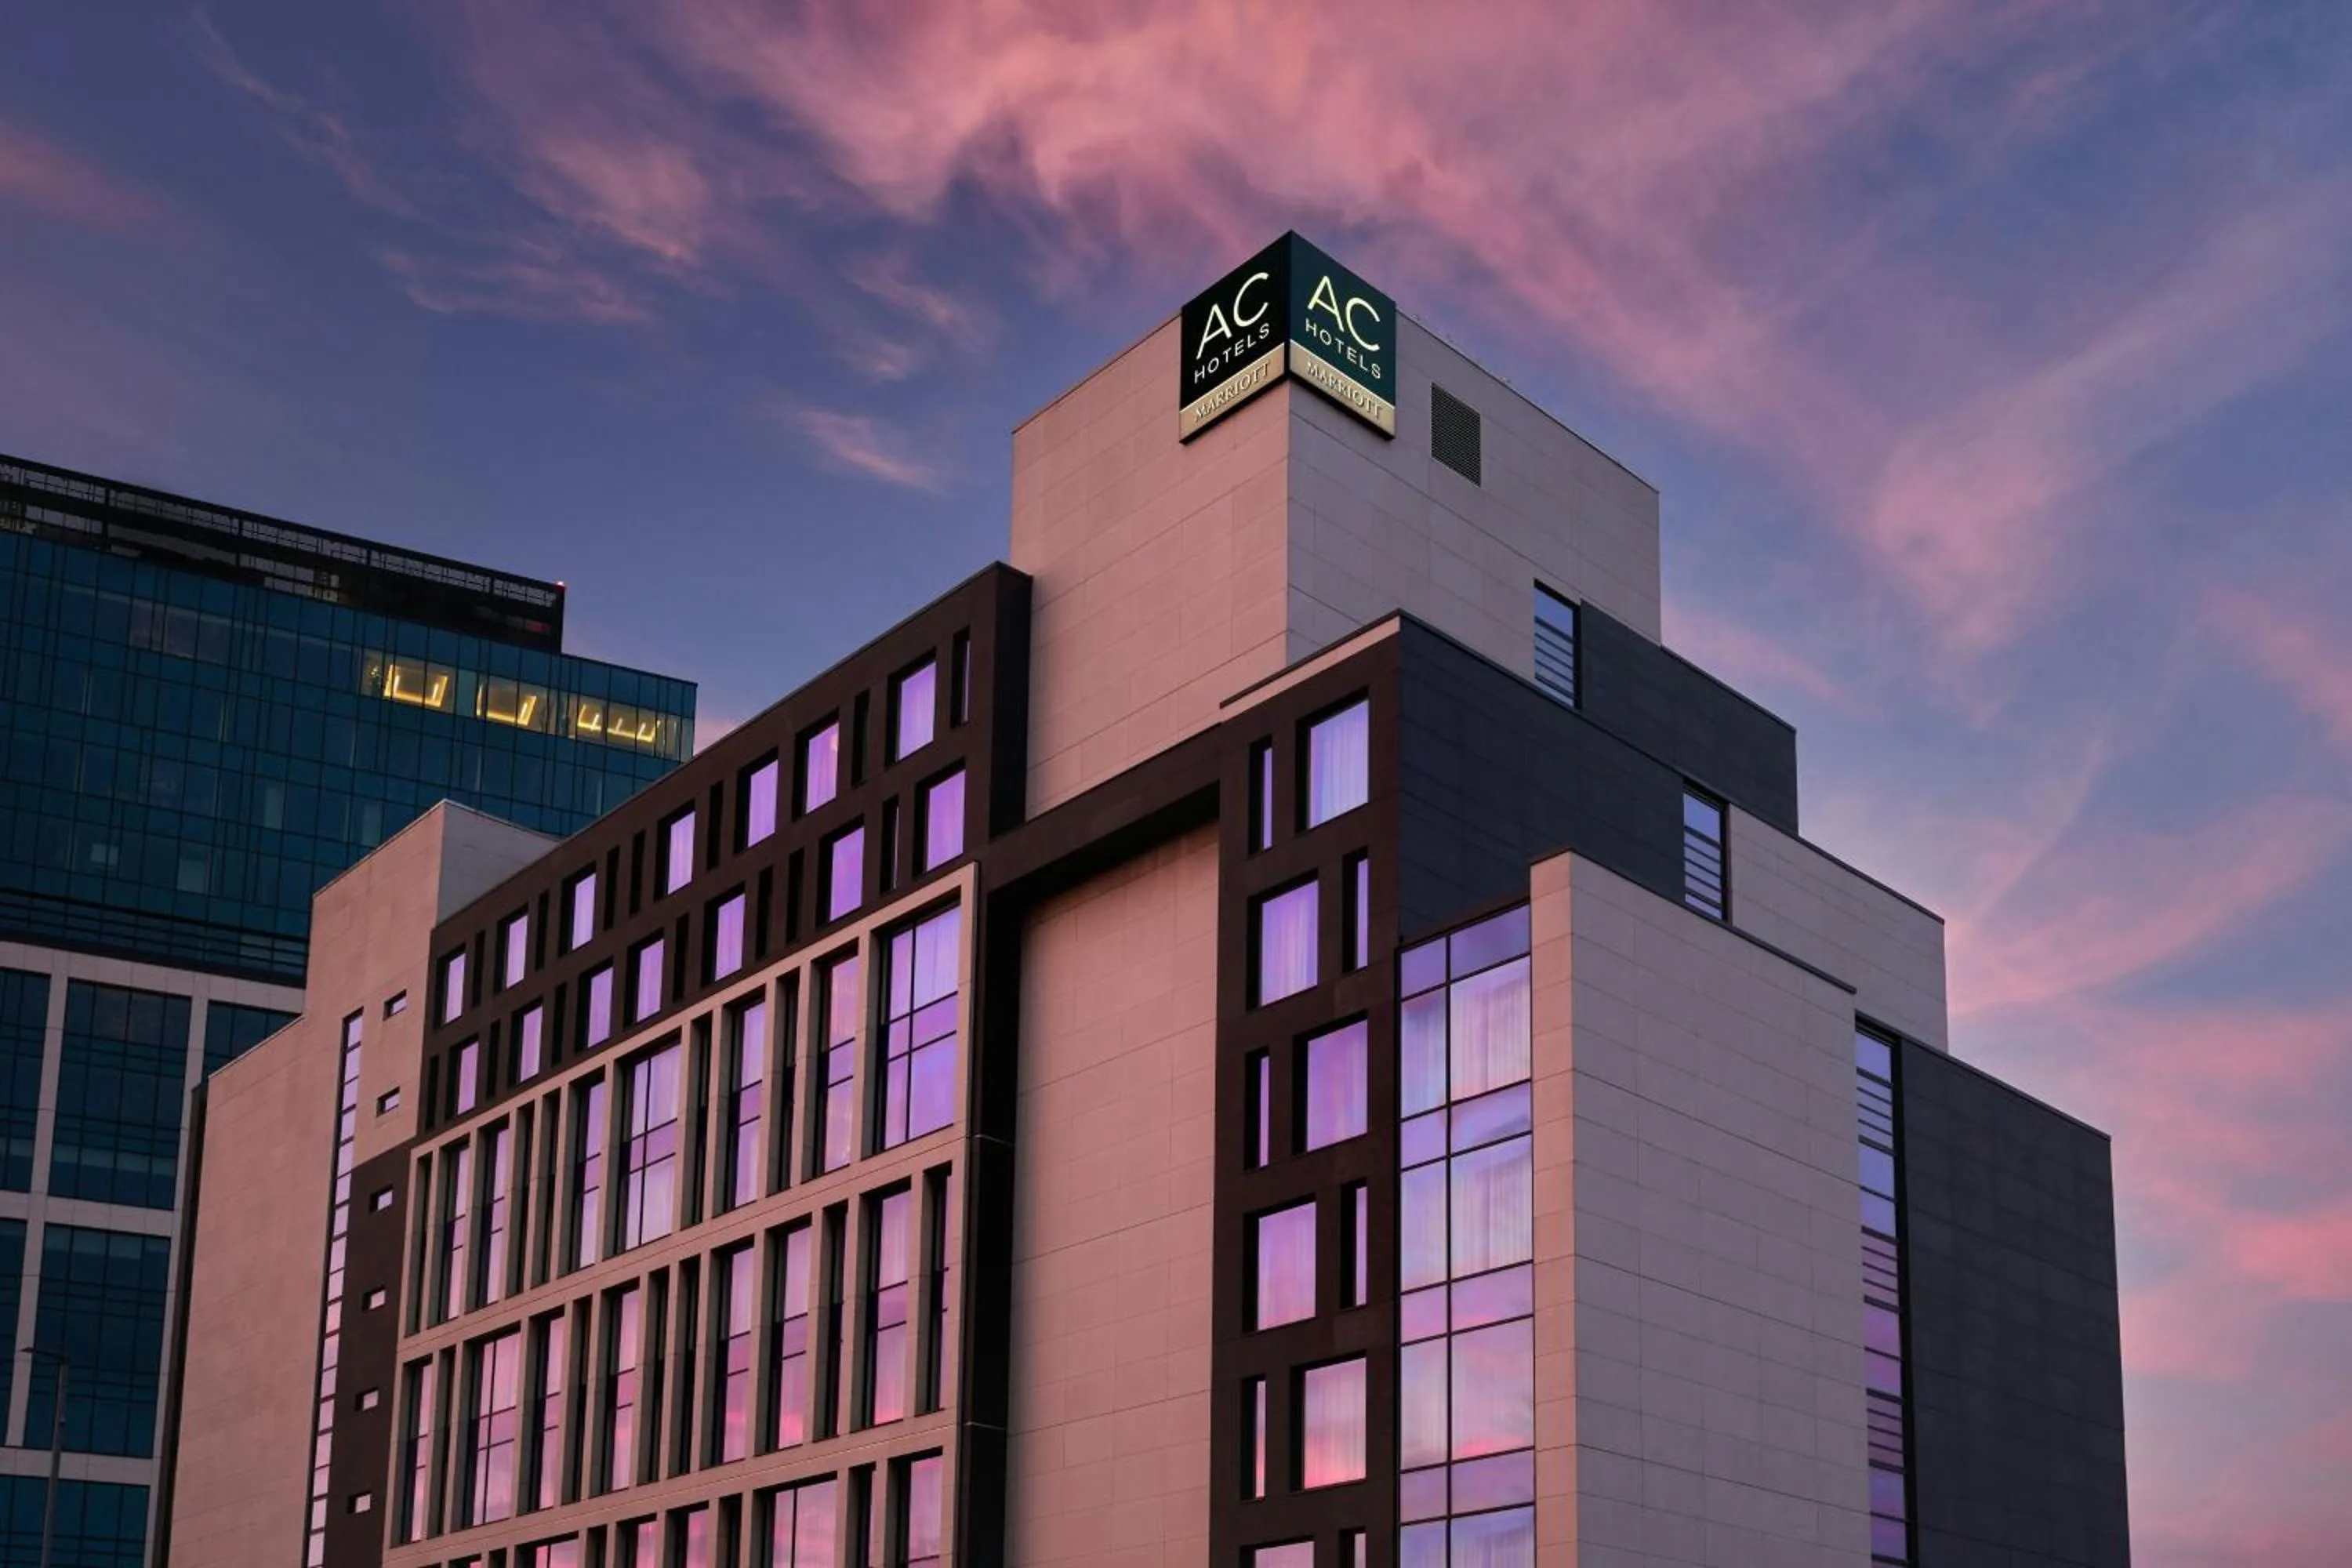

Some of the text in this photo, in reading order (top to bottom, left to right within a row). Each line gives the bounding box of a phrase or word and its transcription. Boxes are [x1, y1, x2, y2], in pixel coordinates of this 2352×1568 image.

[1196, 272, 1269, 360] AC
[1307, 275, 1381, 351] AC
[1194, 322, 1270, 383] HOTELS
[1305, 318, 1381, 379] HOTELS
[1194, 360, 1270, 423] MARRIOTT
[1306, 358, 1383, 421] MARRIOTT
